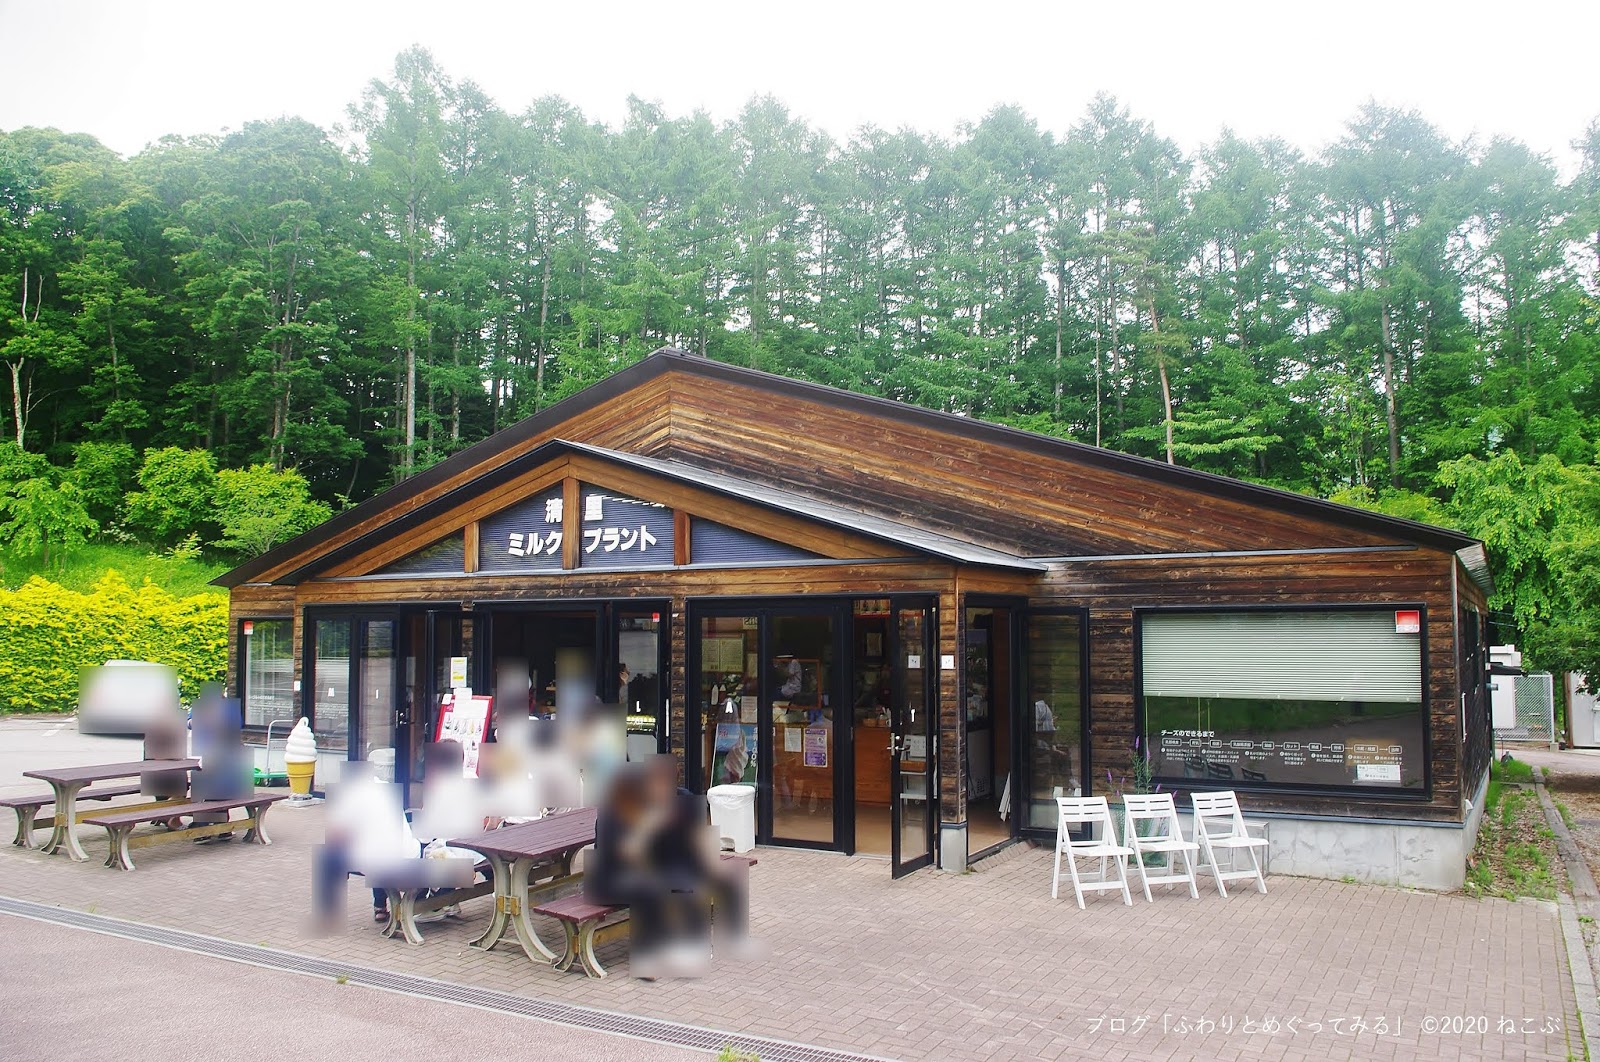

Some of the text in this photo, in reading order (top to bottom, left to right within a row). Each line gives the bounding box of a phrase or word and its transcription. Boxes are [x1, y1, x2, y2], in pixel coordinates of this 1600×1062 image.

[1161, 730, 1215, 738] チーズのできるまで
